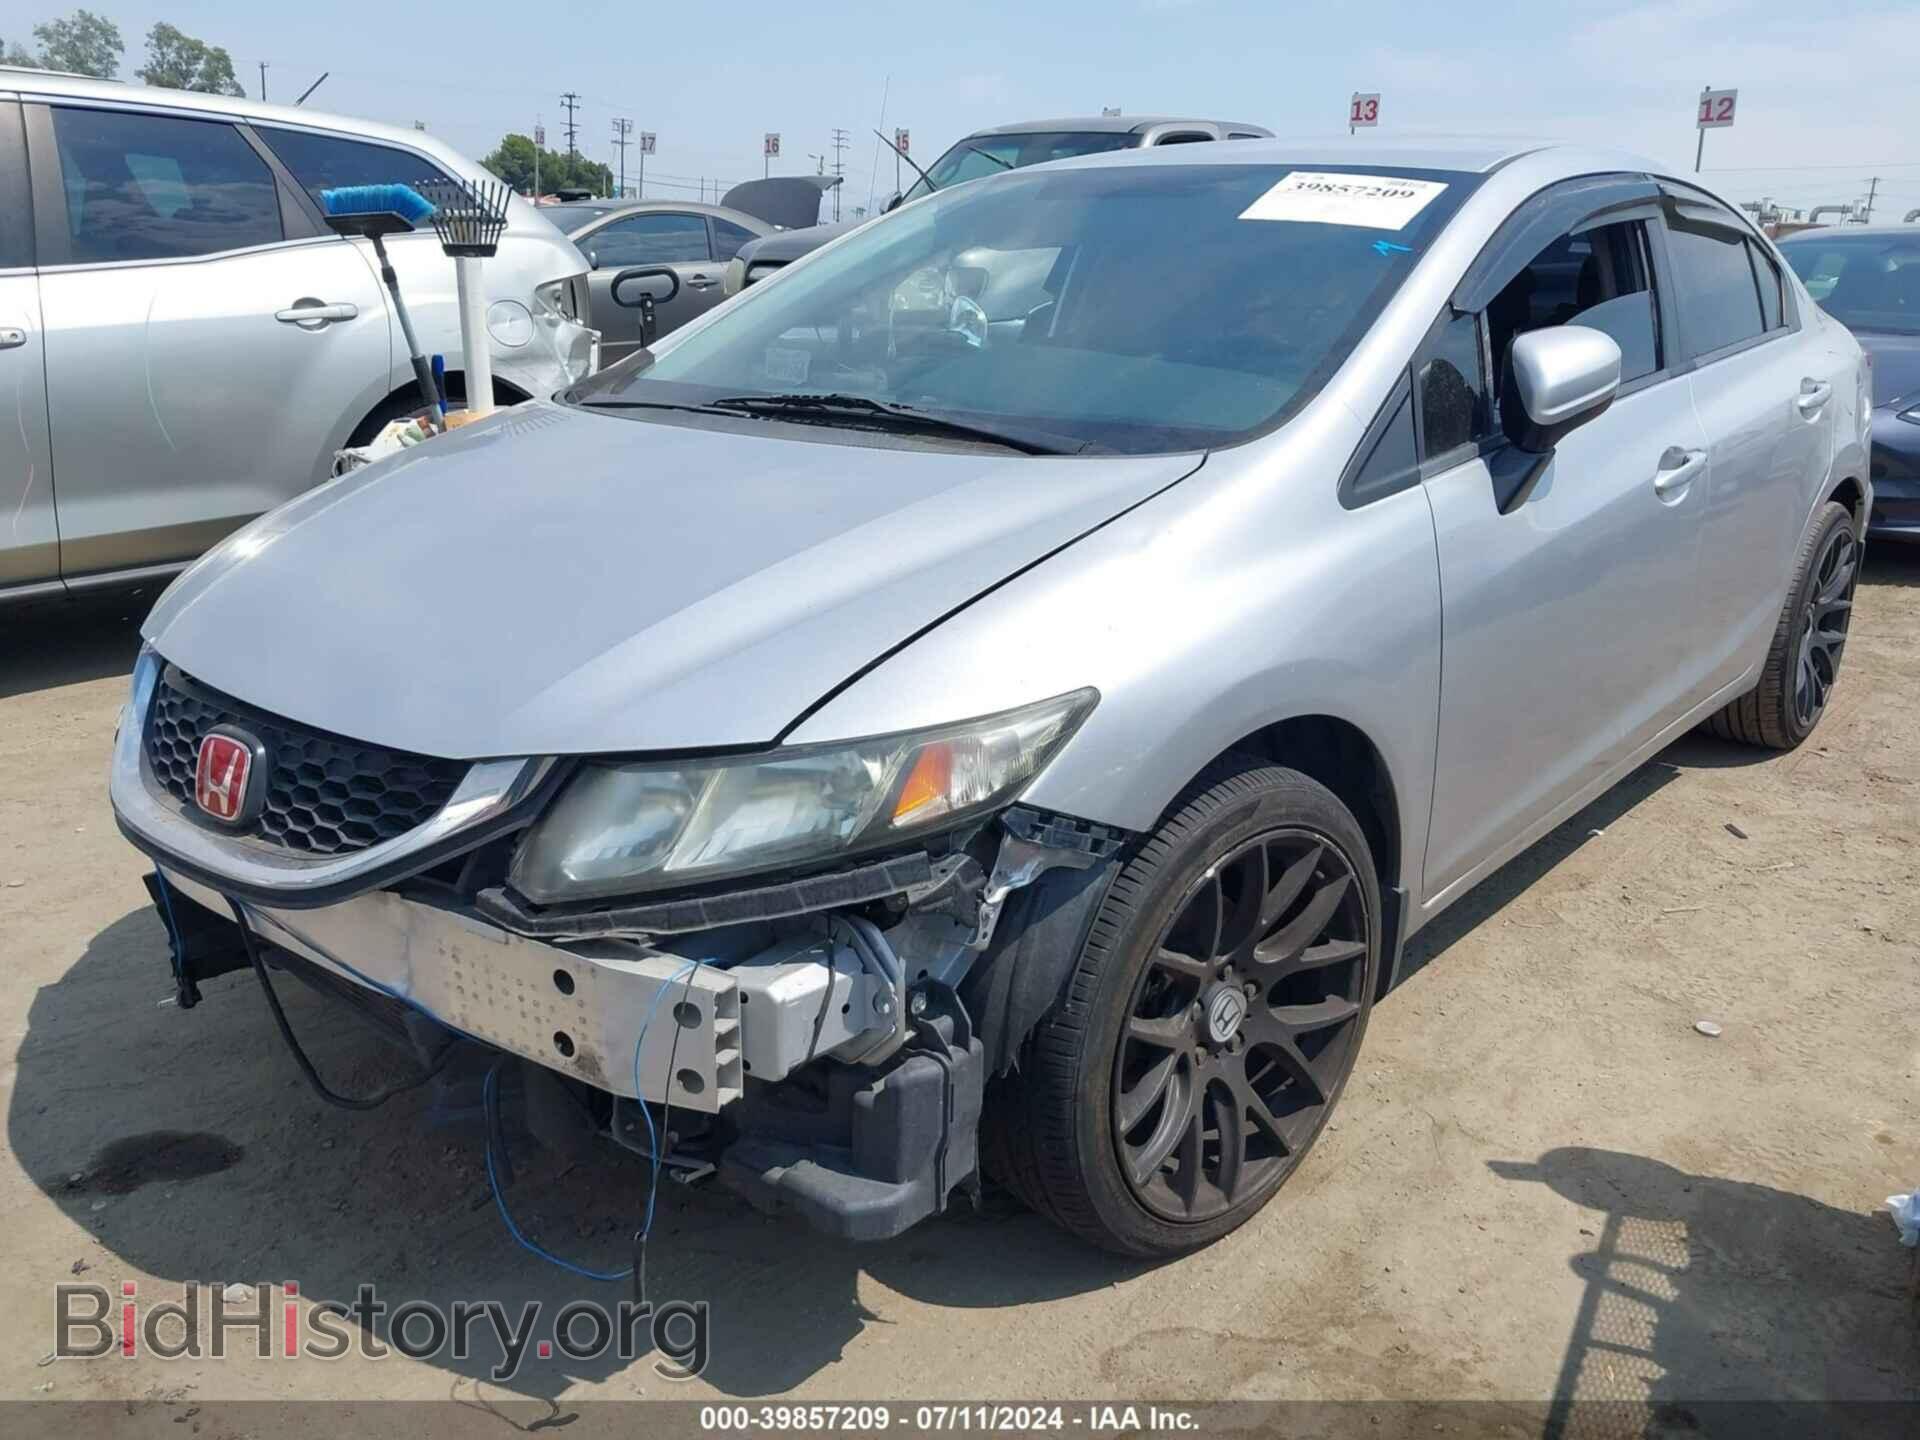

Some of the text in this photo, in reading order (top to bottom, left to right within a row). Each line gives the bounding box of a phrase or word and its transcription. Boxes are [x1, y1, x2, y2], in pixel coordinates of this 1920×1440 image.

[1352, 100, 1377, 121] 13
[1699, 97, 1734, 122] 12
[640, 136, 656, 151] 17
[764, 137, 780, 153] 16
[895, 134, 909, 151] 15
[1289, 181, 1416, 199] 39857209
